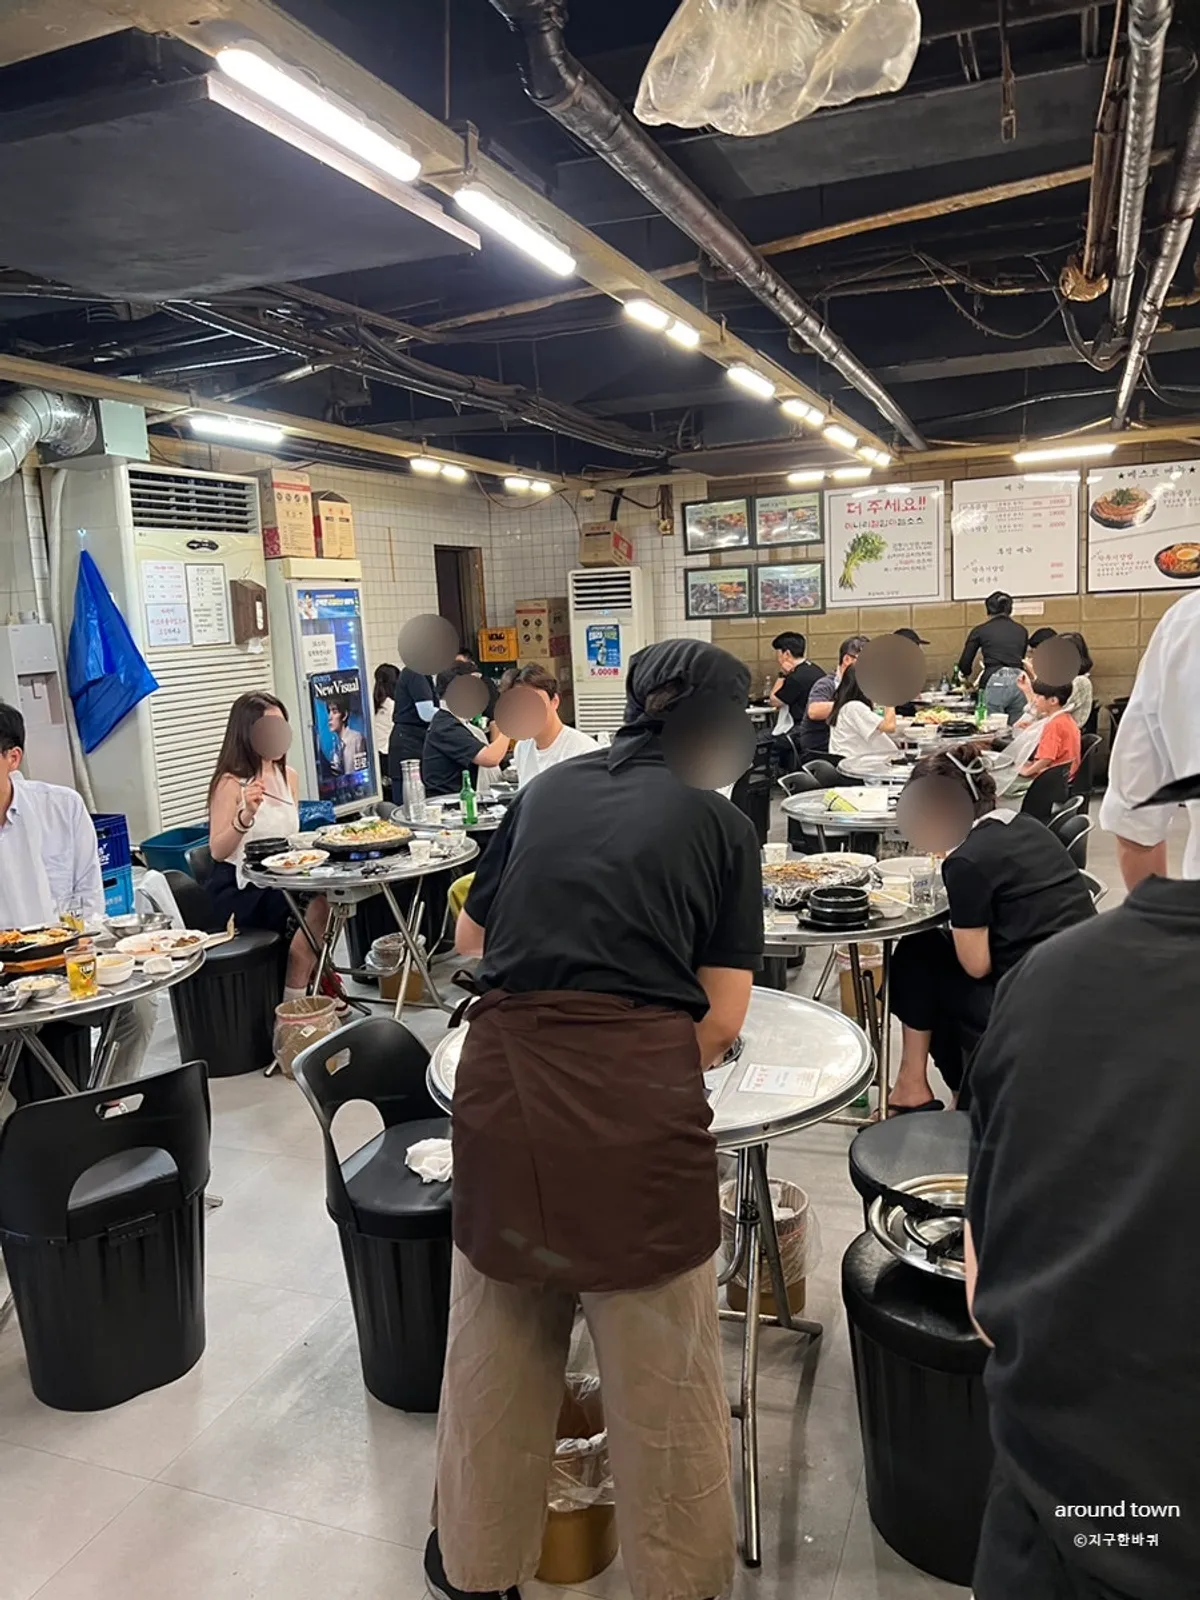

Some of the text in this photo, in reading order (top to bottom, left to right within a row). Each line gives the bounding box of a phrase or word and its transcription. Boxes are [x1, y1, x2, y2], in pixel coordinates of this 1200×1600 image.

[846, 495, 927, 516] 더 주세요!!
[314, 682, 334, 698] New
[332, 677, 360, 695] Visual
